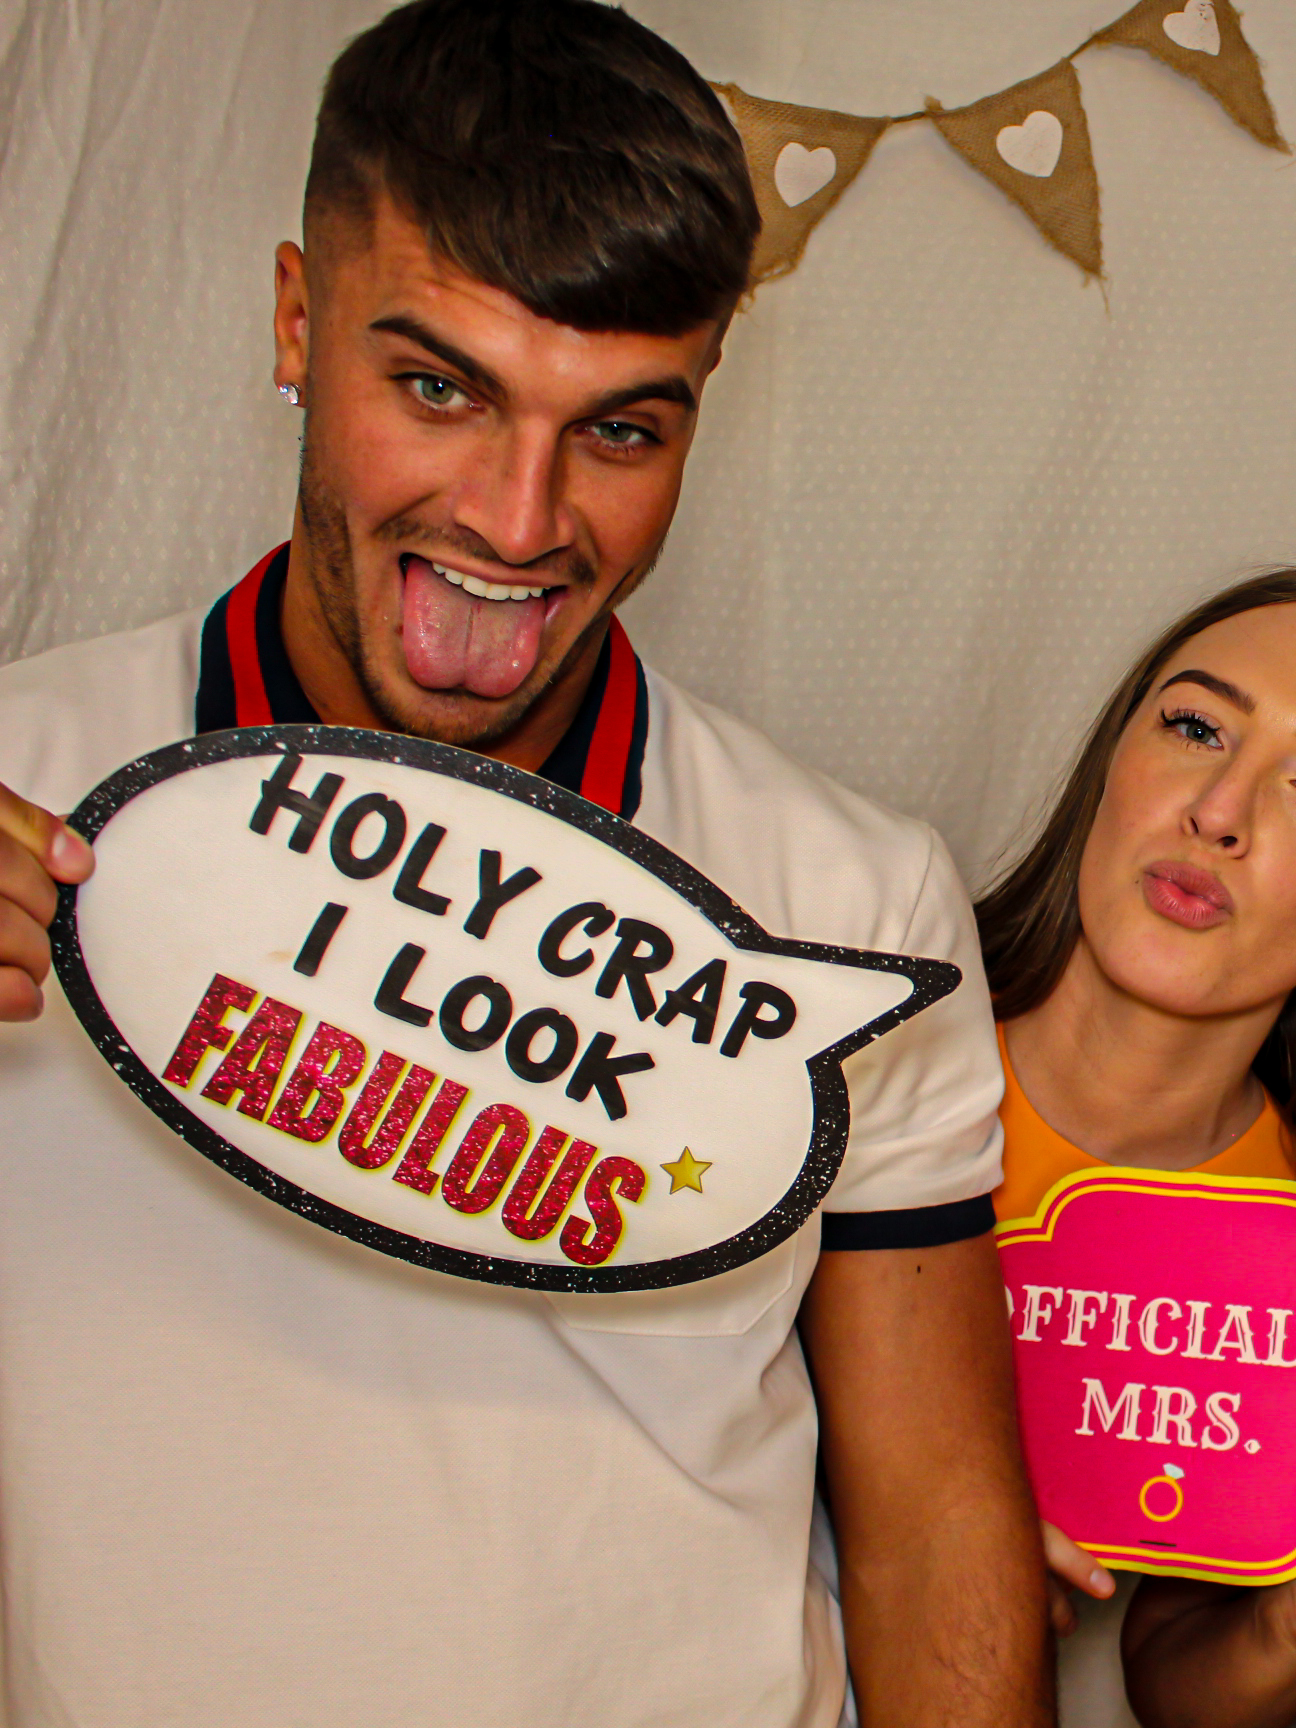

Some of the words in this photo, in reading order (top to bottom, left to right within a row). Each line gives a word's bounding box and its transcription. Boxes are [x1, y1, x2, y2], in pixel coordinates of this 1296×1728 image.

[249, 753, 542, 940] HOLY
[538, 901, 797, 1059] CRAP
[293, 902, 349, 978] I
[374, 942, 655, 1121] LOOK
[161, 972, 649, 1267] FABULOUS
[1075, 1378, 1261, 1455] MRS.
